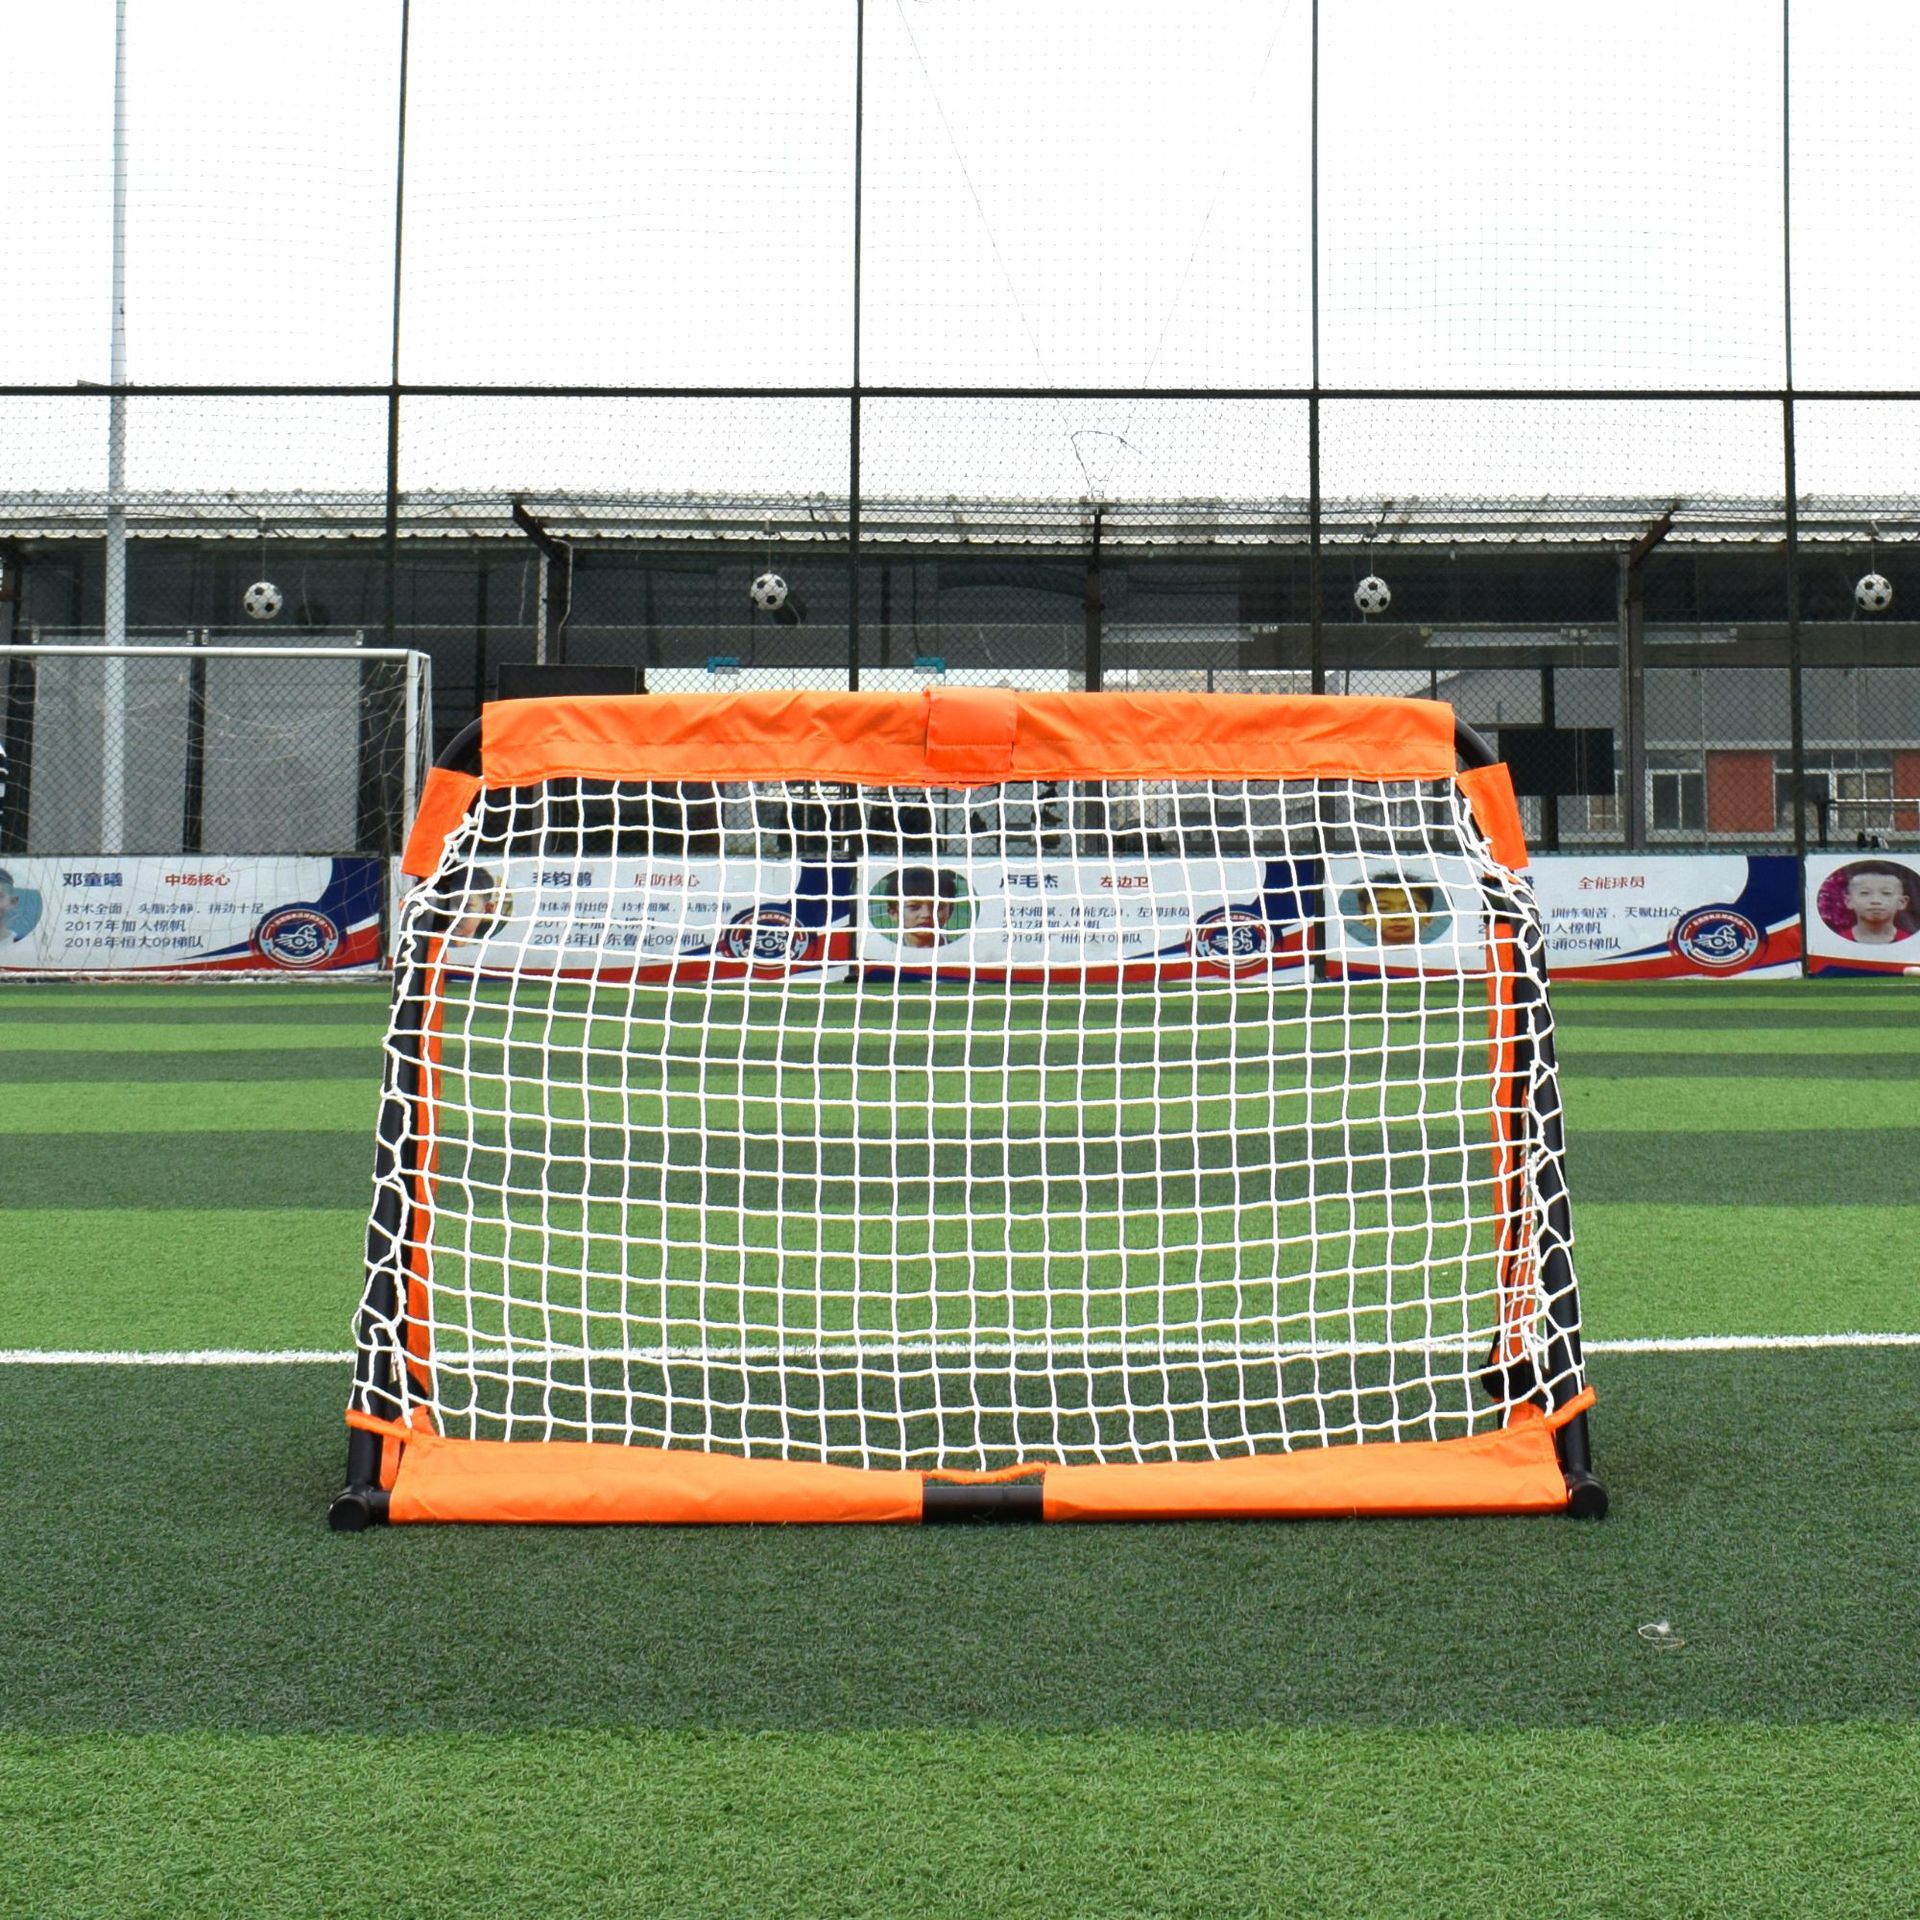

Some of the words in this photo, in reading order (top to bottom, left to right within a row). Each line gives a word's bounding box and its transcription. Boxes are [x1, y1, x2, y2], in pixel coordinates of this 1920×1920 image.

[165, 873, 230, 887] 中场核心
[634, 873, 700, 887] 后防核心
[999, 874, 1059, 888] 卢毛杰
[1100, 875, 1149, 888] 左边卫
[1578, 876, 1645, 890] 全能球员
[65, 936, 203, 948] 2018年恒大09梯队
